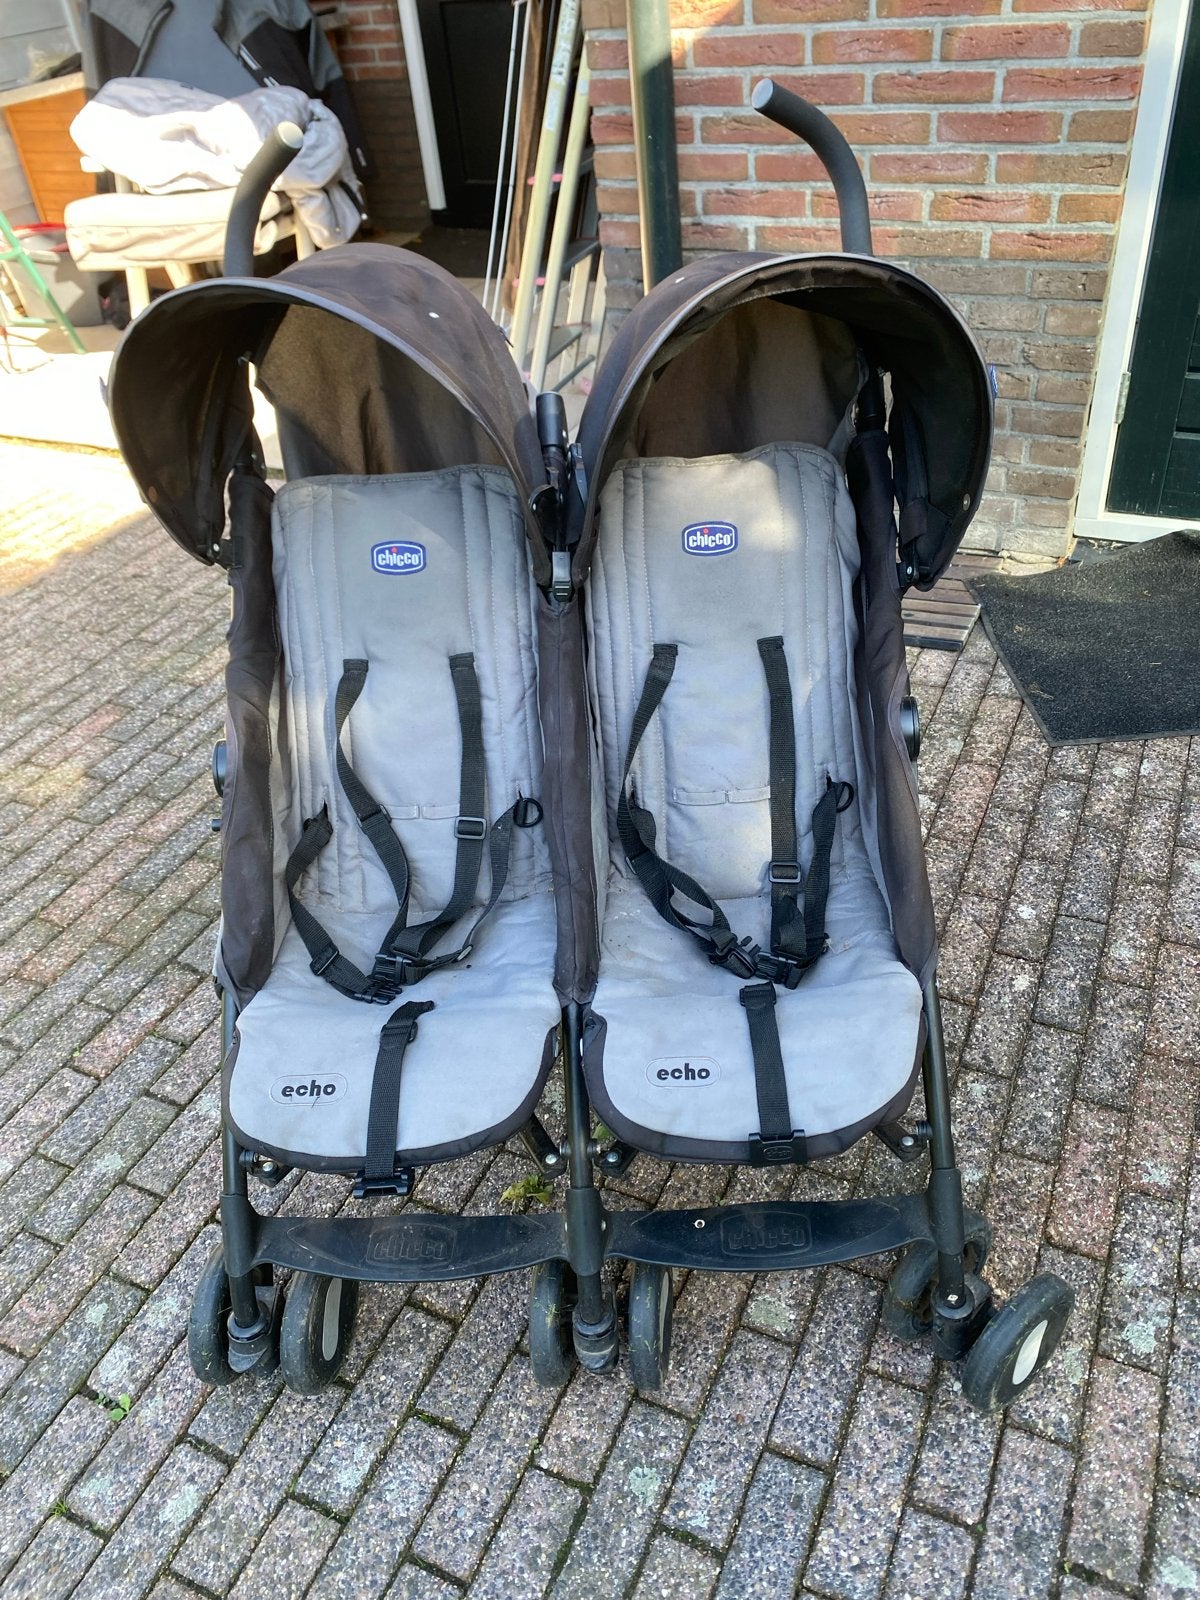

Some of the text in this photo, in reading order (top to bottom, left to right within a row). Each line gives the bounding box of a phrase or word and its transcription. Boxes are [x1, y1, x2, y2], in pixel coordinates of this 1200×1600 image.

[688, 527, 732, 548] chicco
[377, 546, 420, 567] chicco
[656, 1063, 711, 1081] echo
[281, 1080, 337, 1098] echo
